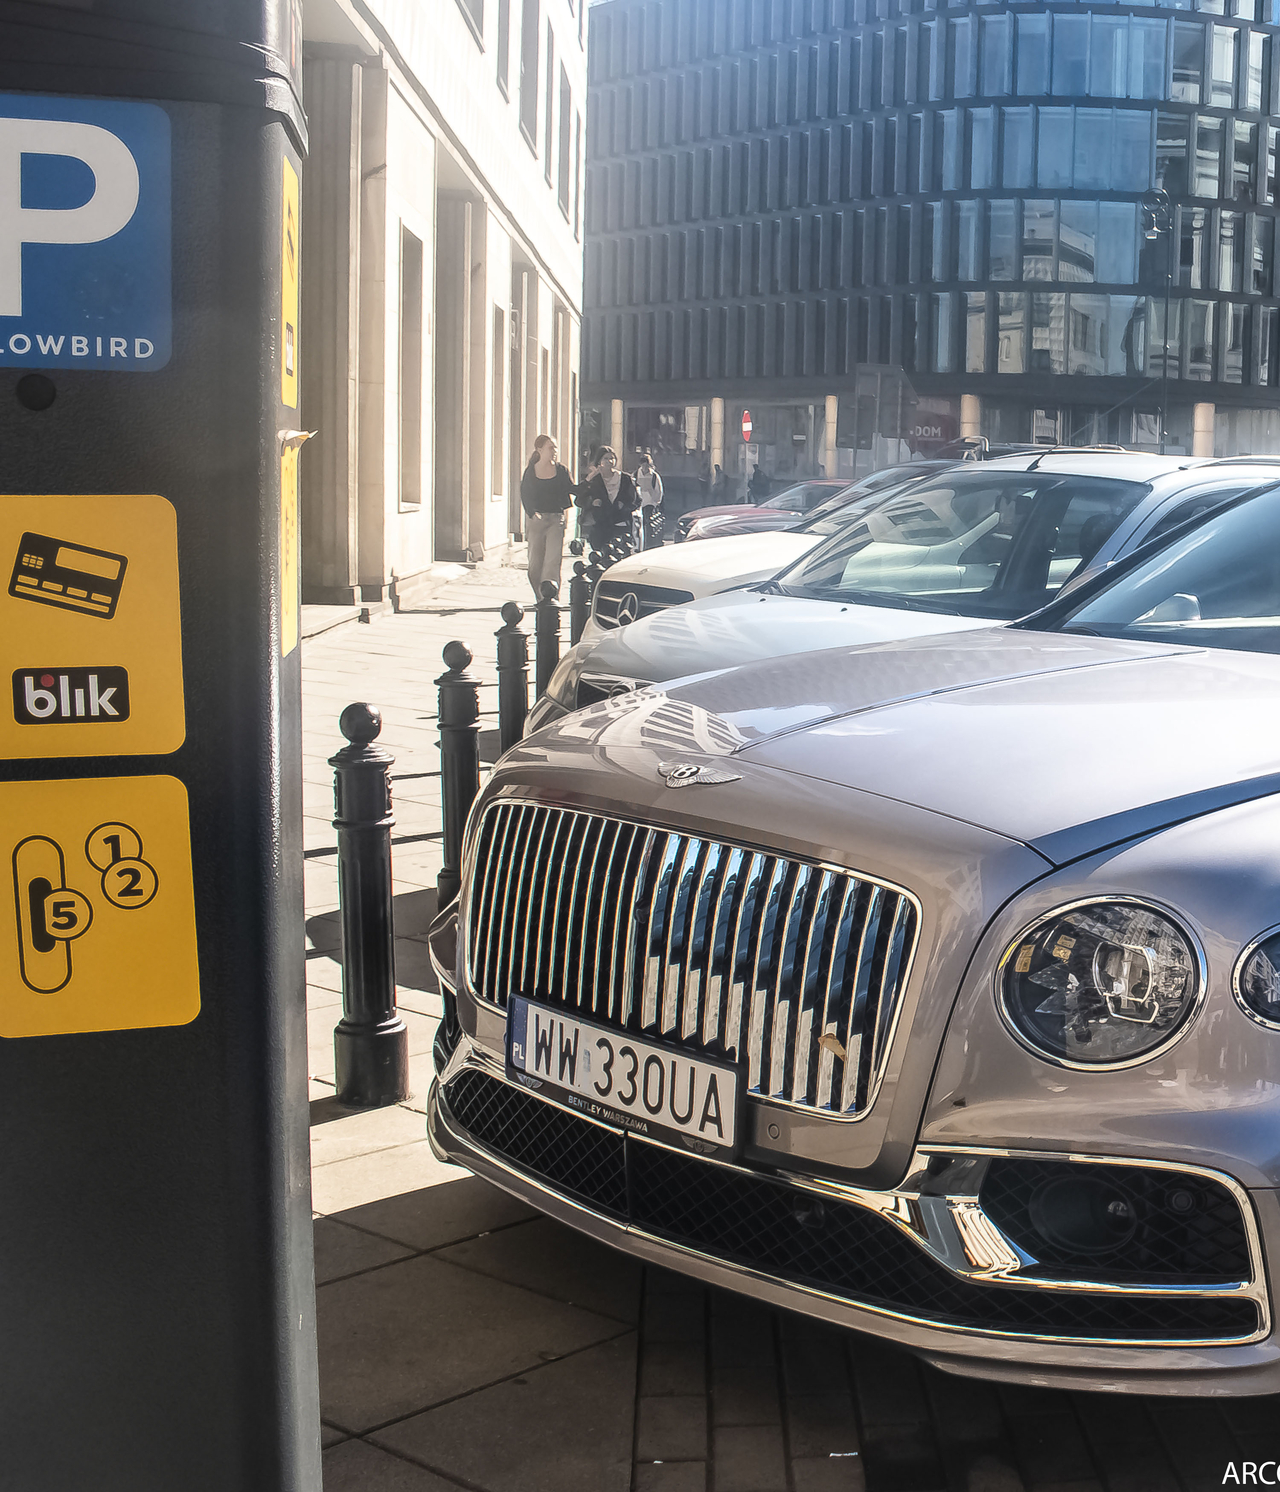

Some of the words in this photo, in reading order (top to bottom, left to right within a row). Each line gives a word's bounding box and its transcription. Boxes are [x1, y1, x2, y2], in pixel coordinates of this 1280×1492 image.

[0, 118, 139, 316] P
[0, 333, 155, 359] OWBIRD
[24, 674, 120, 718] blik
[512, 1041, 525, 1060] PL
[534, 1013, 580, 1088] WW
[593, 1037, 725, 1140] 330UA
[568, 1094, 602, 1115] BENTLEY
[602, 1108, 649, 1133] WARSZAWA
